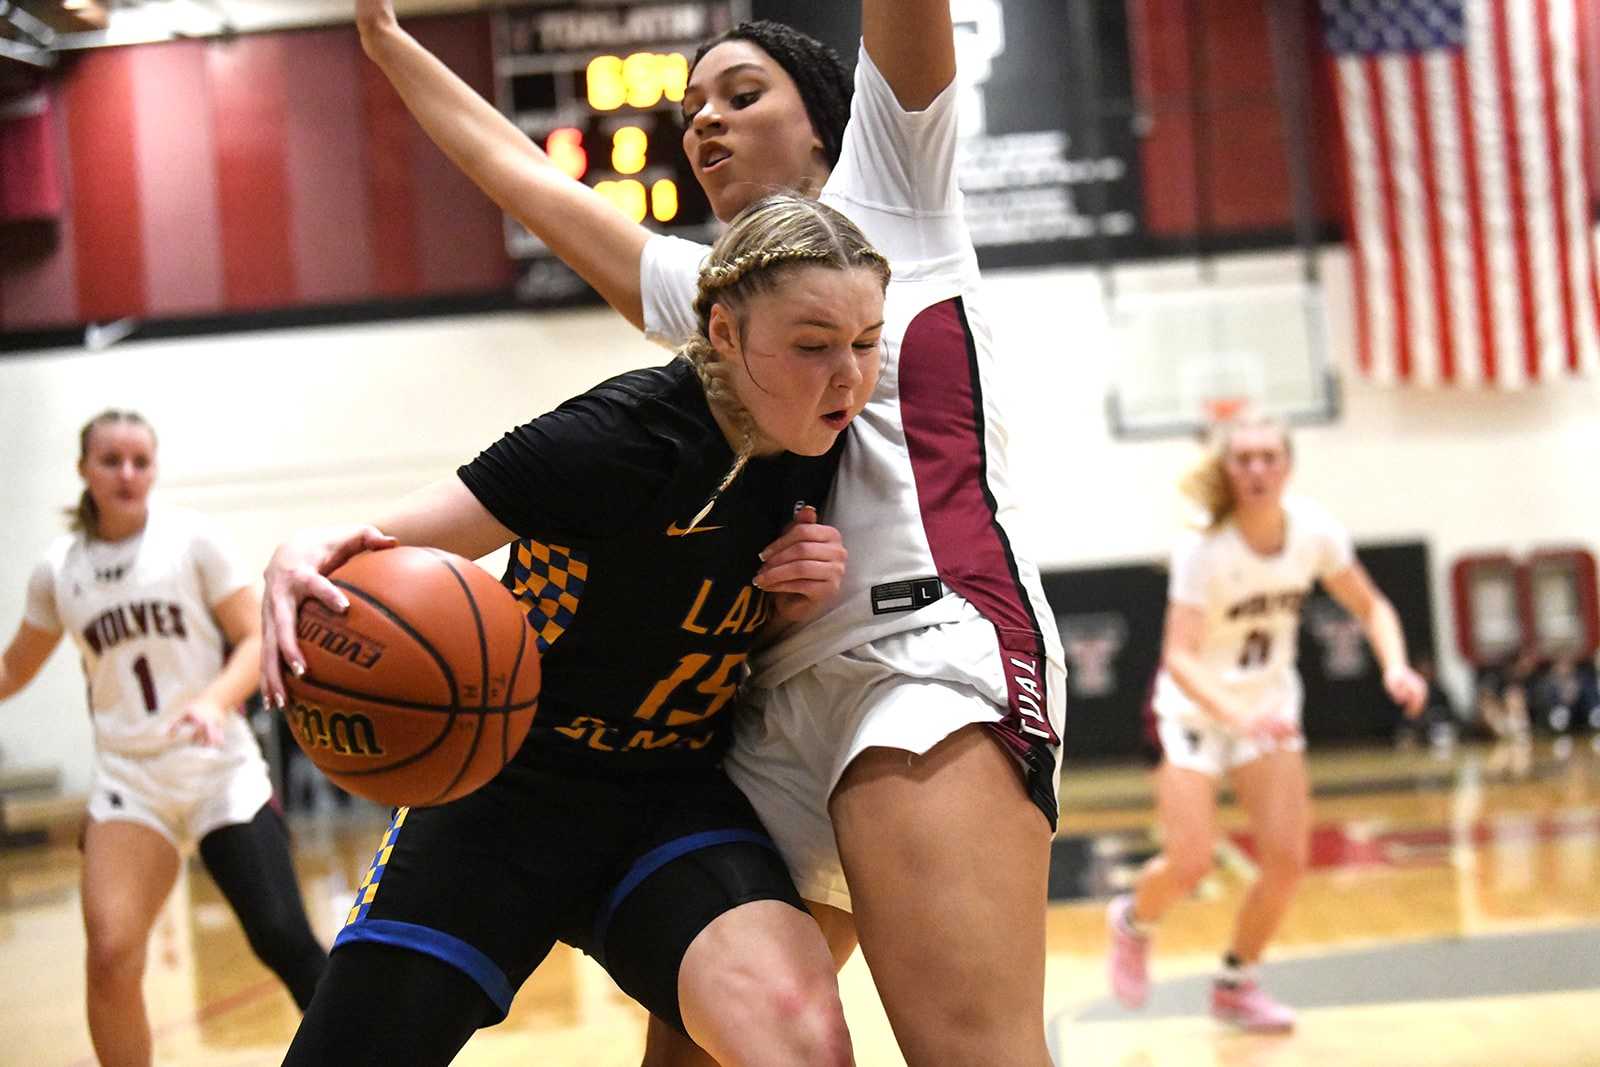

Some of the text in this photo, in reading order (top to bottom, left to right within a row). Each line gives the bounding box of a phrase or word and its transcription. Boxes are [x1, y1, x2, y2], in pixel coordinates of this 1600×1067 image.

[921, 587, 932, 599] L
[83, 599, 187, 656] WOLVES
[297, 617, 383, 671] EVOLU
[134, 653, 159, 714] 1
[634, 653, 748, 727] 15
[294, 703, 386, 757] Wil
